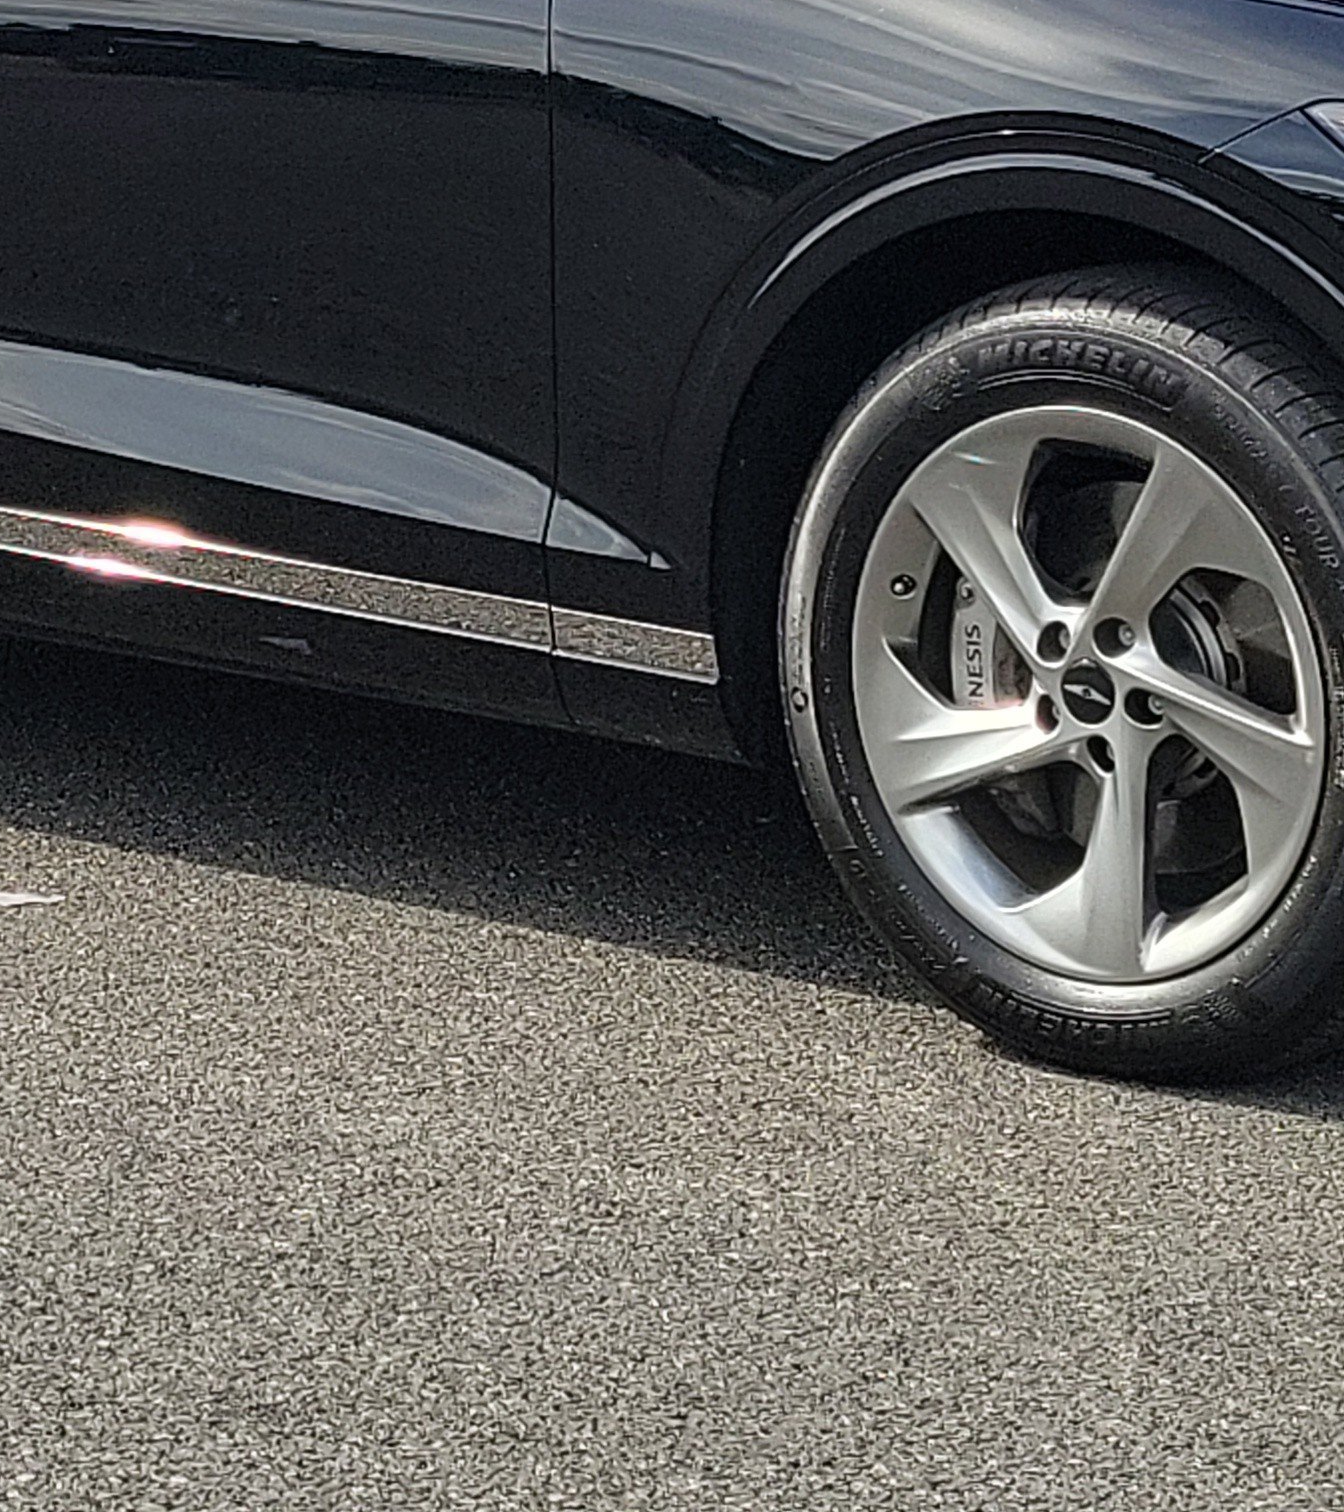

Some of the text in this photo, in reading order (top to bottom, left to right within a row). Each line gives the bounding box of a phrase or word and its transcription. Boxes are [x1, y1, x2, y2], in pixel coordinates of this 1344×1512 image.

[977, 338, 1190, 402] MICHELIN
[1295, 504, 1341, 570] TOUR
[965, 623, 985, 706] NESIS
